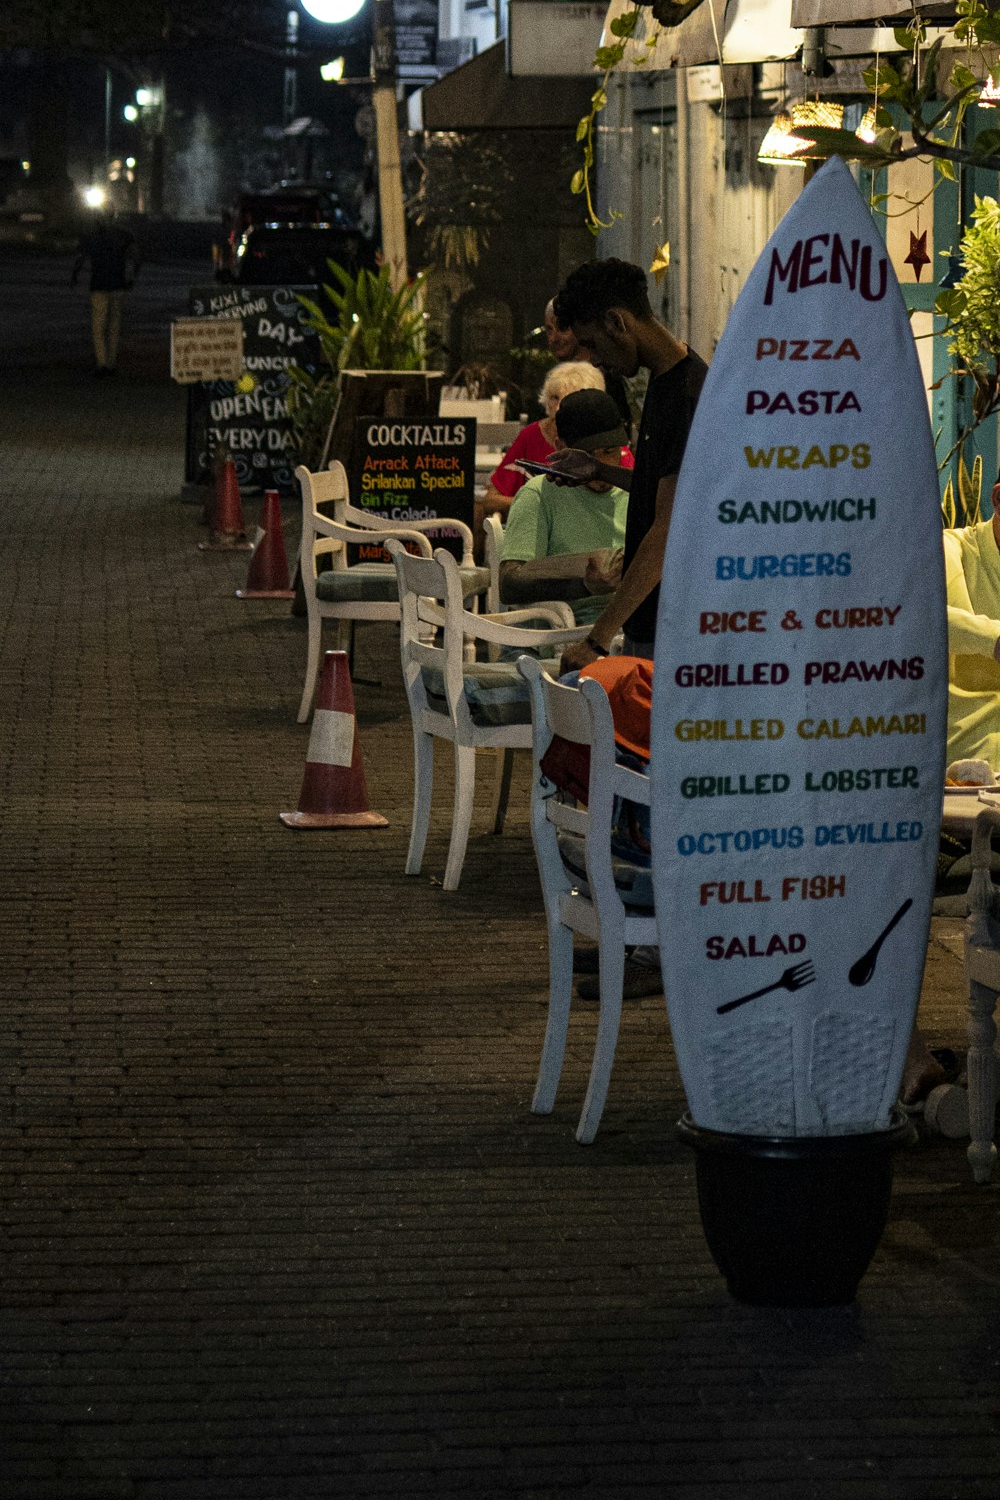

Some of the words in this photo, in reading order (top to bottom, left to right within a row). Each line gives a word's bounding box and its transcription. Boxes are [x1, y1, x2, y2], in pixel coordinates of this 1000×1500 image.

[763, 233, 888, 306] MENU
[258, 318, 304, 346] DAY
[756, 337, 861, 362] PIZZA
[210, 385, 262, 421] OPEN
[746, 390, 862, 416] PASTA
[367, 425, 466, 446] COCKTAILS
[364, 455, 409, 470] Arrack
[415, 454, 460, 470] Attack
[743, 443, 871, 470] WRAPS
[421, 471, 465, 492] Special
[360, 492, 379, 507] Gin
[384, 492, 409, 506] Fizz
[391, 506, 437, 520] Colada
[717, 497, 877, 525] SANDWICH
[716, 552, 852, 581] BURGERS
[699, 610, 768, 635] RICE
[780, 609, 804, 632] &
[814, 605, 902, 630] CURRY
[675, 662, 790, 688] GRILLED
[804, 656, 925, 685] PRAWNS
[674, 718, 784, 743] GRILLED
[796, 713, 926, 740] CALAMARI
[680, 773, 790, 799] GRILLED
[804, 766, 919, 793] LOBSTER
[677, 826, 804, 856] OCTOPUS
[815, 820, 923, 847] DEVILLED
[700, 882, 771, 906] FULL
[782, 875, 846, 900] FISH
[705, 933, 807, 960] SALAD
